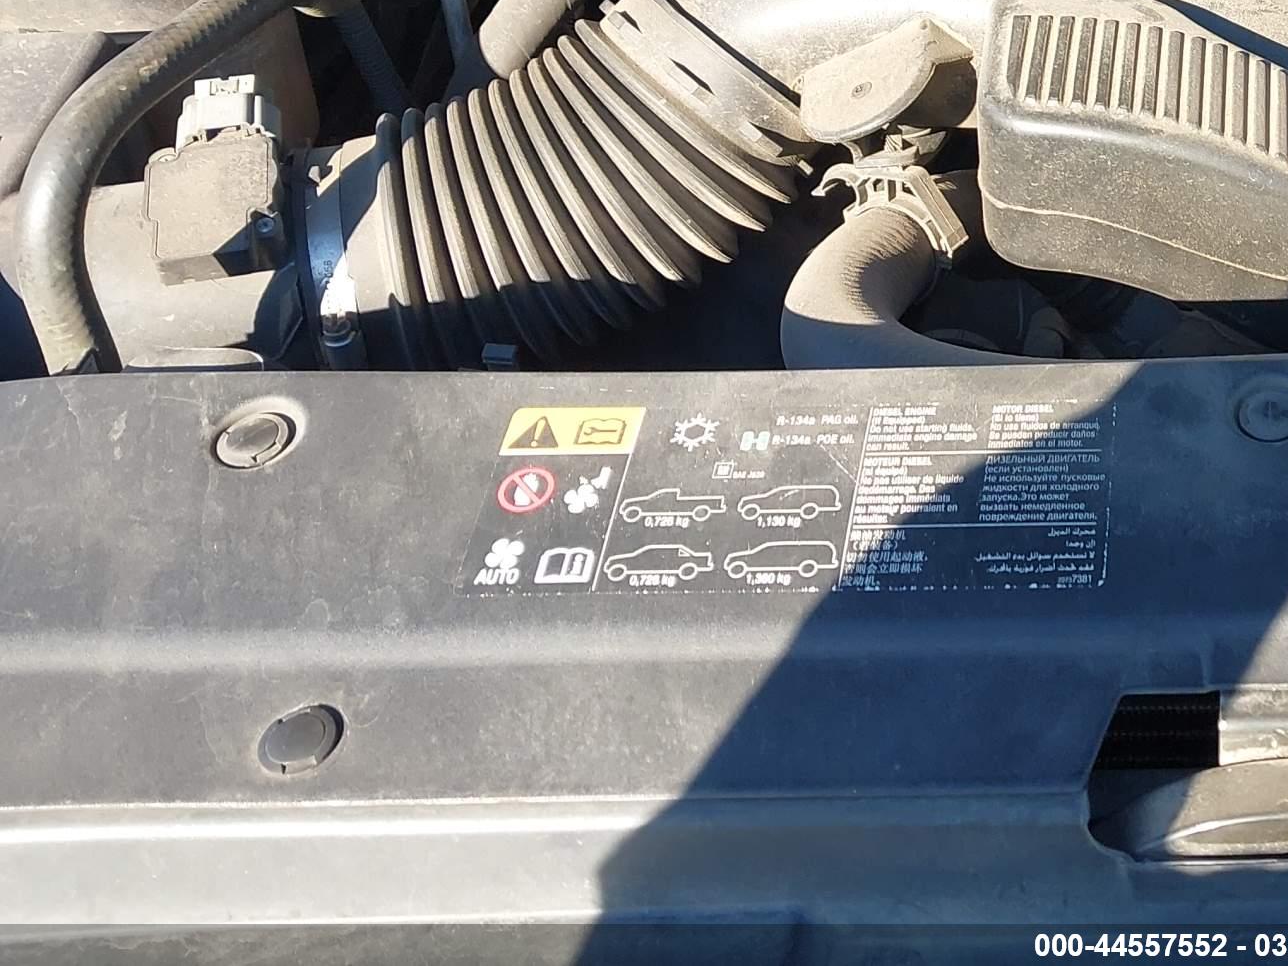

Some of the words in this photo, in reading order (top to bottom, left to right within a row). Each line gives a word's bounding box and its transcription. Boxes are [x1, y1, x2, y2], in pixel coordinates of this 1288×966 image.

[873, 407, 903, 416] DIESEL
[905, 407, 936, 416] ENGINE
[992, 405, 1023, 414] MOTOR
[1025, 404, 1054, 413] DIESEL
[776, 415, 816, 426] R-134a
[821, 415, 842, 425] PAG
[1050, 421, 1060, 429] de
[870, 425, 881, 433] Do
[883, 424, 897, 433] not
[915, 423, 948, 433] starting
[772, 434, 811, 445] R-134a
[817, 434, 838, 444] POE
[914, 433, 942, 442] engine
[944, 432, 977, 442] damage
[1035, 430, 1068, 440] producir
[866, 442, 881, 451] can
[988, 439, 1033, 448] inmediatos
[1048, 439, 1056, 447] el
[864, 457, 900, 467] MOTEUR
[901, 456, 932, 466] DIESEL
[986, 454, 1046, 465] ДИЗЕЛЬНЫЙ
[1047, 454, 1100, 464] ДВИГАТЕЛЬ
[985, 464, 1010, 474] (если
[1012, 464, 1069, 474] установлен)
[923, 474, 934, 484] de
[935, 474, 964, 484] liquide
[984, 474, 996, 482] Не
[999, 473, 1058, 483] используйте
[1061, 474, 1105, 483] пусковые
[982, 483, 1029, 492] жидкости
[1030, 483, 1048, 492] для
[1049, 483, 1099, 492] холодного
[1039, 493, 1069, 501] может
[980, 503, 1019, 511] вызвать
[1021, 502, 1085, 511] немедленное
[787, 515, 801, 528] kg
[979, 512, 1045, 522] повреждение
[675, 516, 690, 529] kg
[473, 567, 520, 585] AUTO
